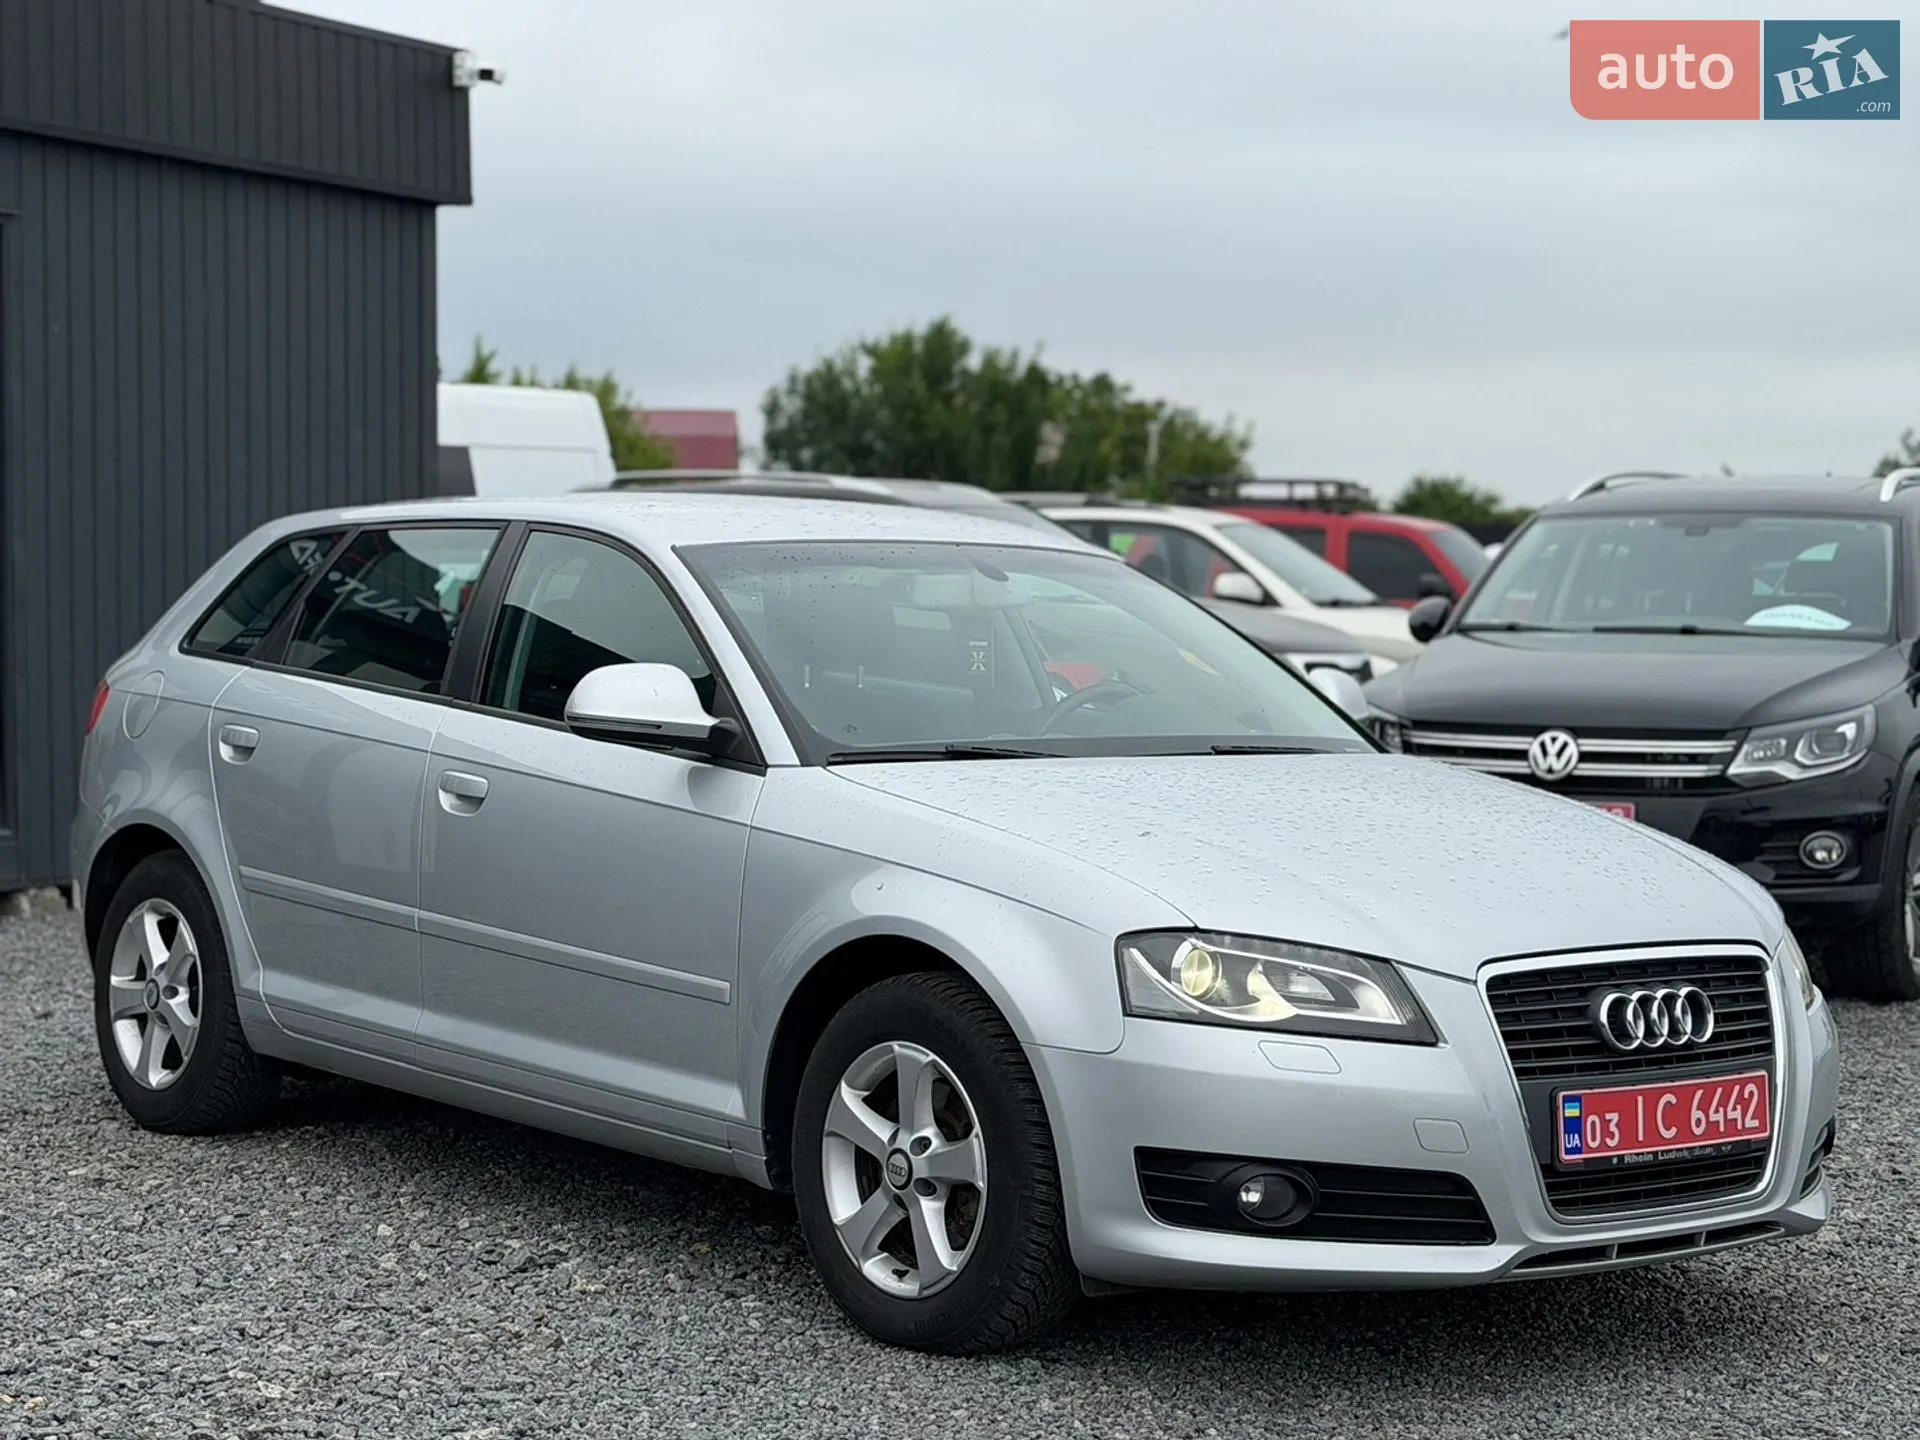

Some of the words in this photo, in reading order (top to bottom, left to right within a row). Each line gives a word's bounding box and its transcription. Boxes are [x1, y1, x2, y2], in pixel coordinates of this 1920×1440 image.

[1586, 1112, 1620, 1149] 03
[1690, 1082, 1760, 1136] 6442
[1564, 1133, 1581, 1149] UA
